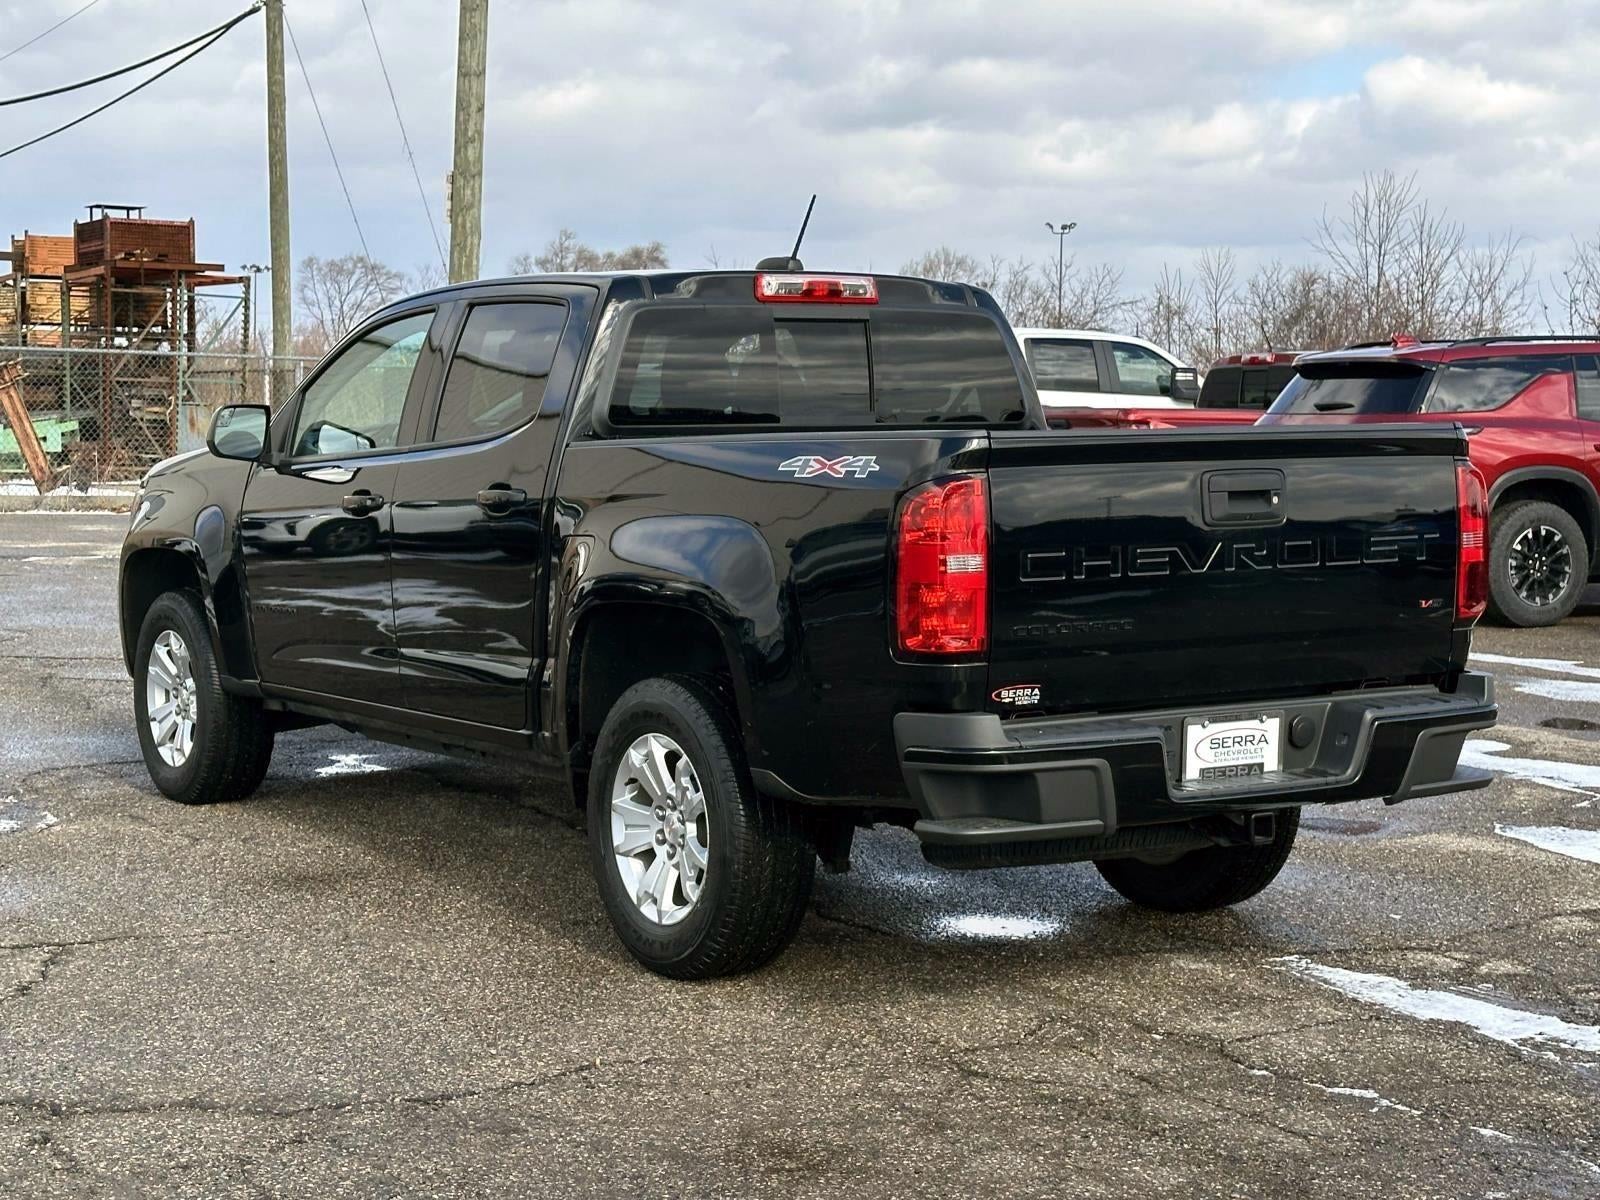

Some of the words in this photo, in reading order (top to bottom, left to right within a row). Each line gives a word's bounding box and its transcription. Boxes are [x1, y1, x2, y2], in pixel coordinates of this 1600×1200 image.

[1018, 532, 1441, 582] CHEVROLET
[1000, 688, 1040, 698] SERRA
[1209, 734, 1269, 750] SERRA
[1214, 747, 1264, 758] CHEVROLET
[1203, 765, 1261, 780] SERRA
